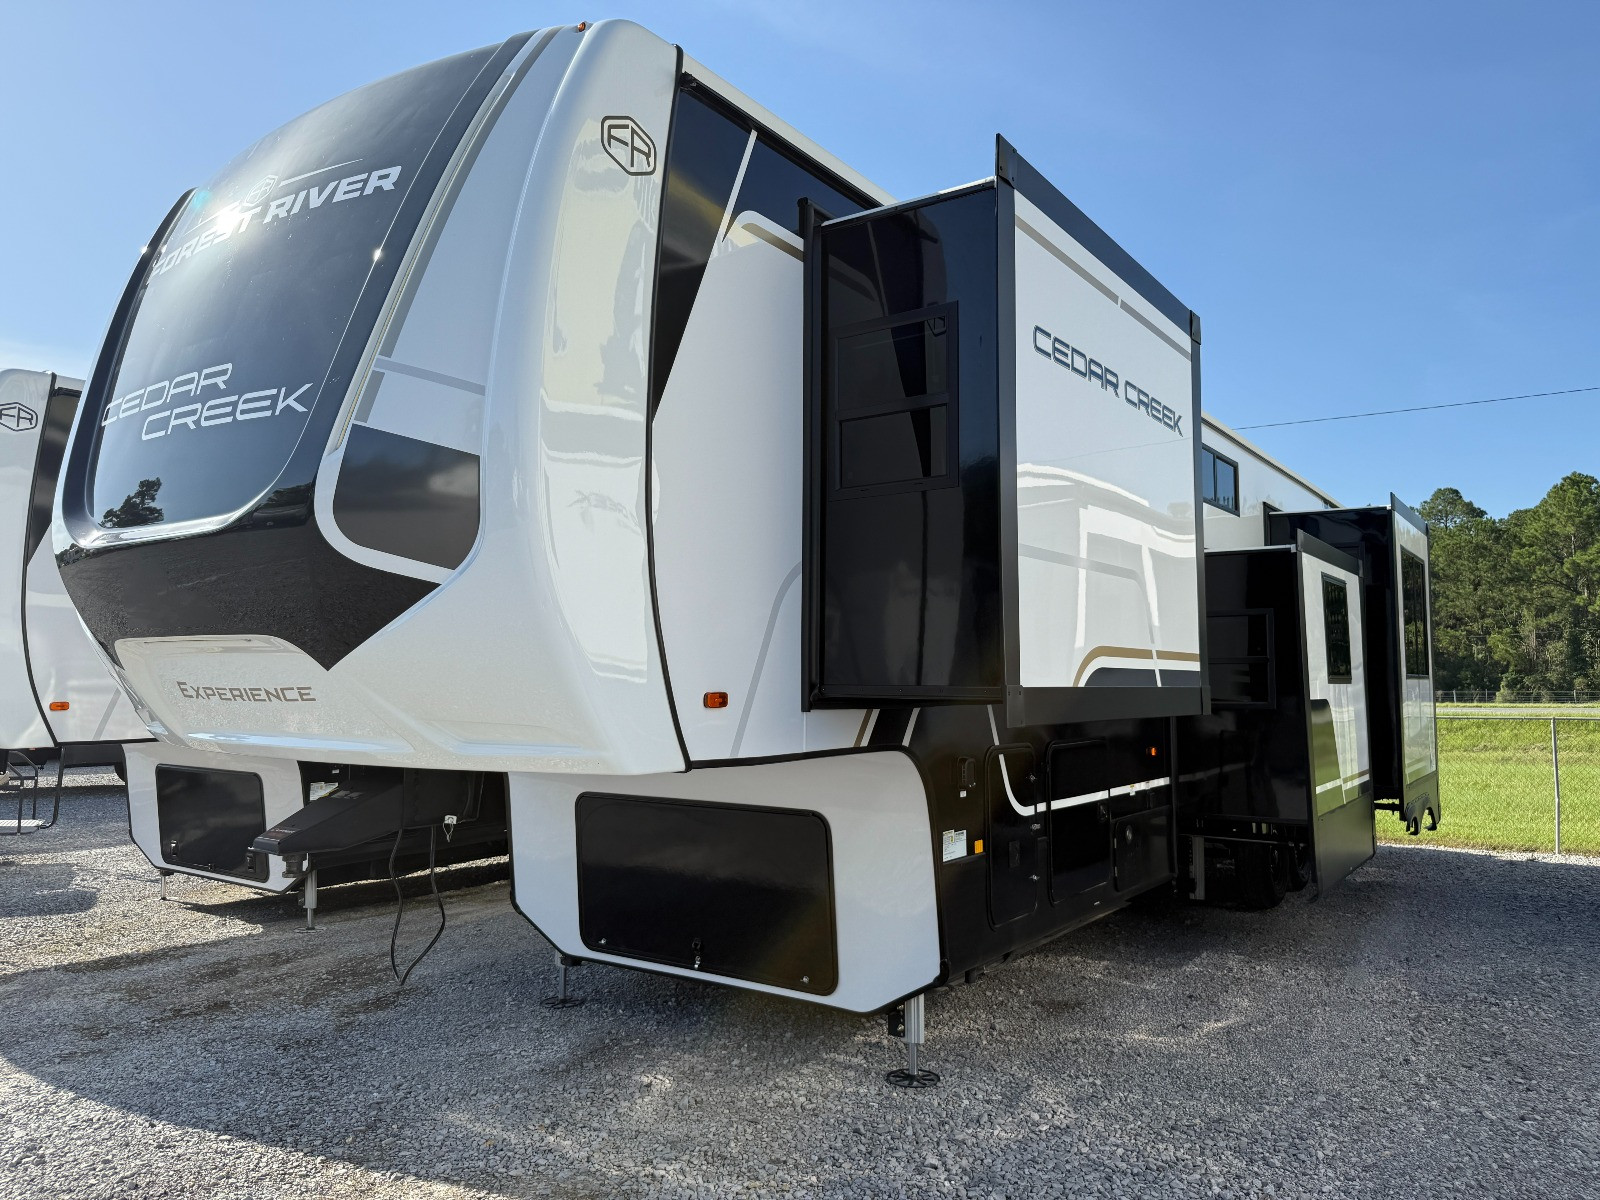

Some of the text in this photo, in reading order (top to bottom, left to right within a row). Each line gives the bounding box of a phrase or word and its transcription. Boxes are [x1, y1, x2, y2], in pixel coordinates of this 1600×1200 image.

[263, 166, 402, 225] RIVER
[101, 363, 233, 427] CEDAR
[141, 382, 314, 441] CREEK
[1032, 324, 1184, 438] CEDAR CREEK
